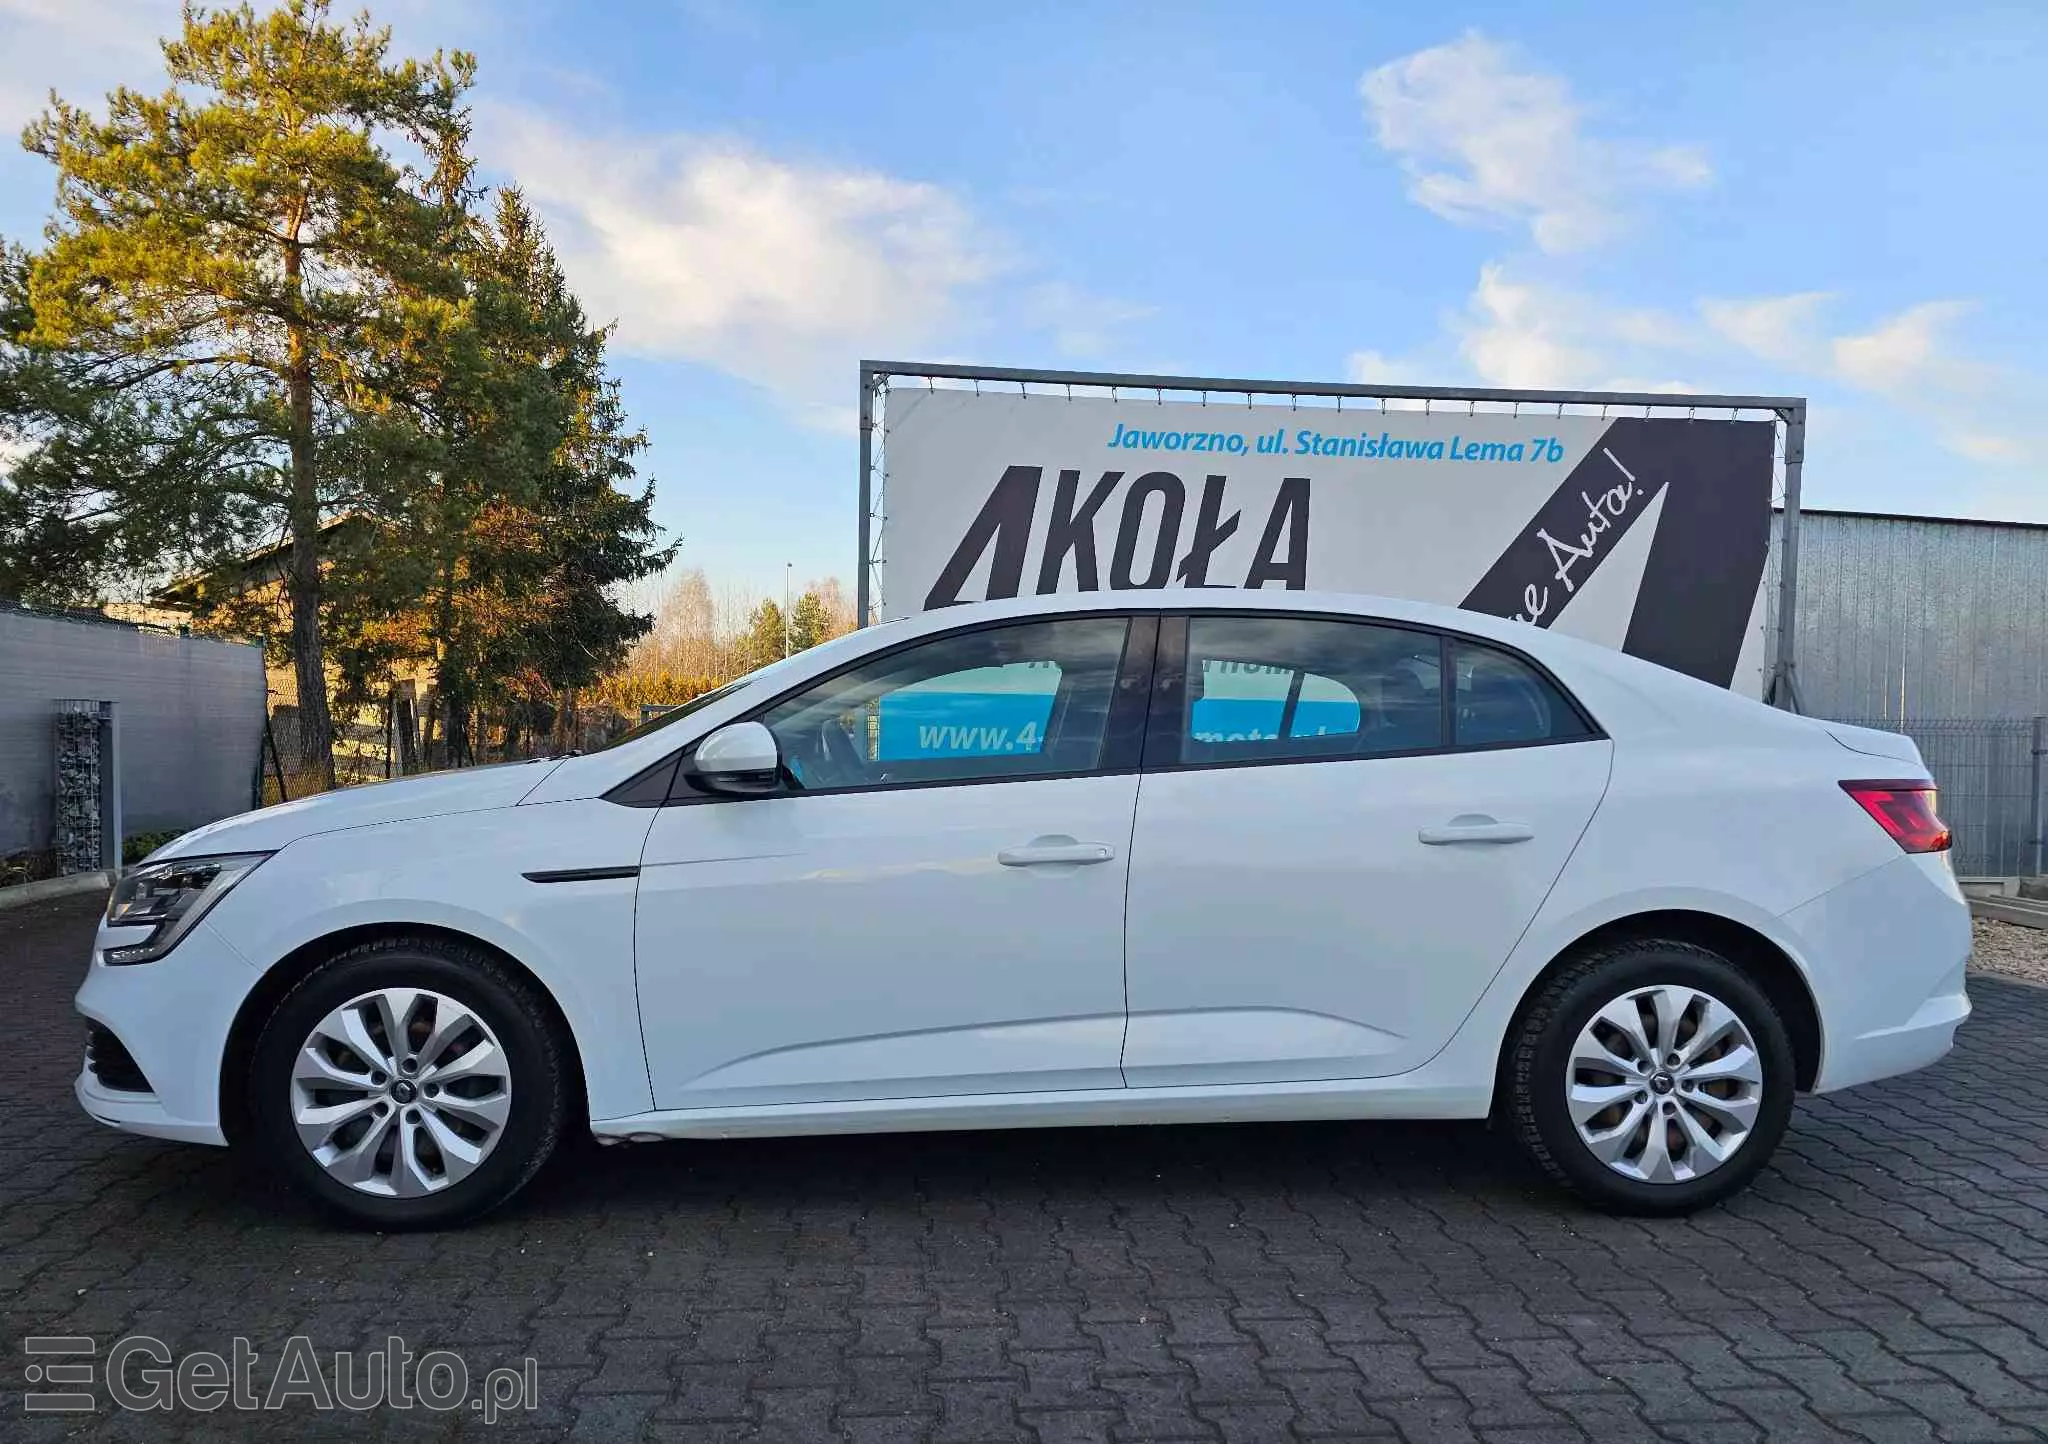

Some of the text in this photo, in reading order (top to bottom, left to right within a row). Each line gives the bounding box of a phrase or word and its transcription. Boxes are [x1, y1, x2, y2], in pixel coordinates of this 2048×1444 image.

[1107, 423, 1564, 463] Jaworzno, ul. Stanisława Lema 7b
[1536, 446, 1645, 593] Auta!
